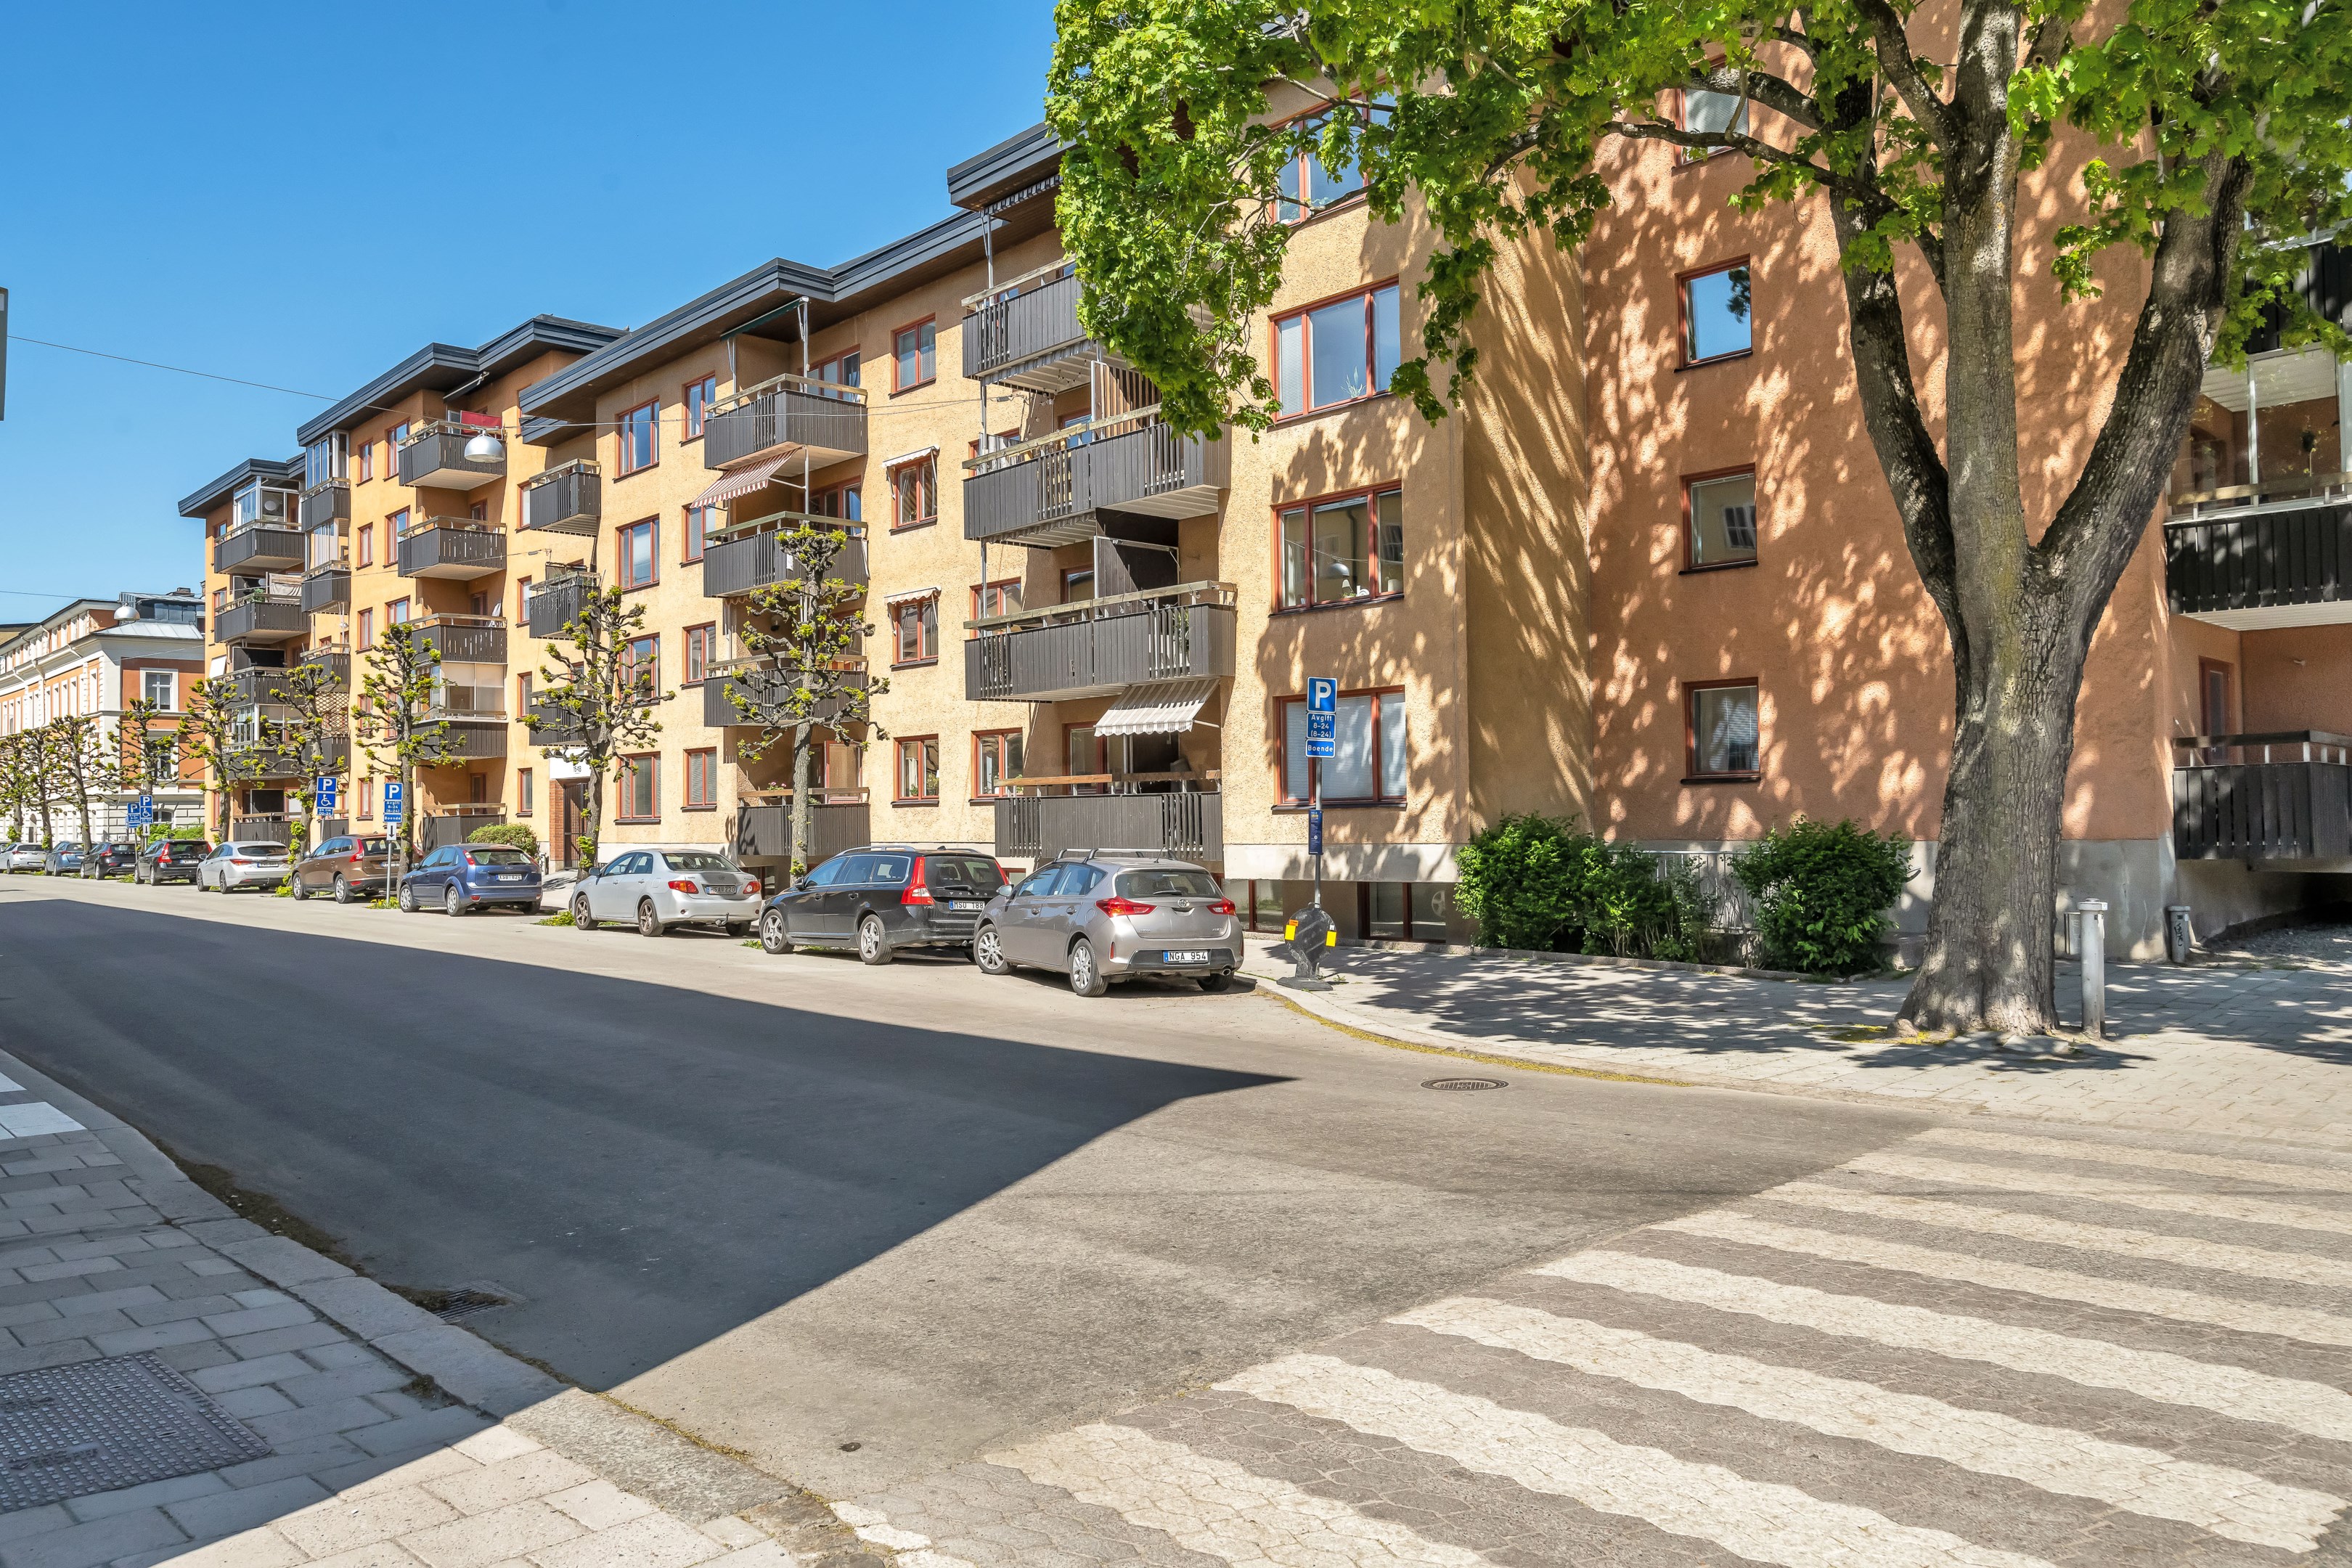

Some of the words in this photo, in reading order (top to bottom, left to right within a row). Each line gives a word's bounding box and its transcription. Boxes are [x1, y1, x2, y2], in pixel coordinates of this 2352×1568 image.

[1315, 681, 1331, 709] P
[322, 778, 332, 791] P
[389, 785, 399, 799] P
[143, 796, 150, 806] P
[131, 804, 137, 812] P
[1169, 952, 1185, 960] NGA
[1191, 951, 1206, 960] 954
